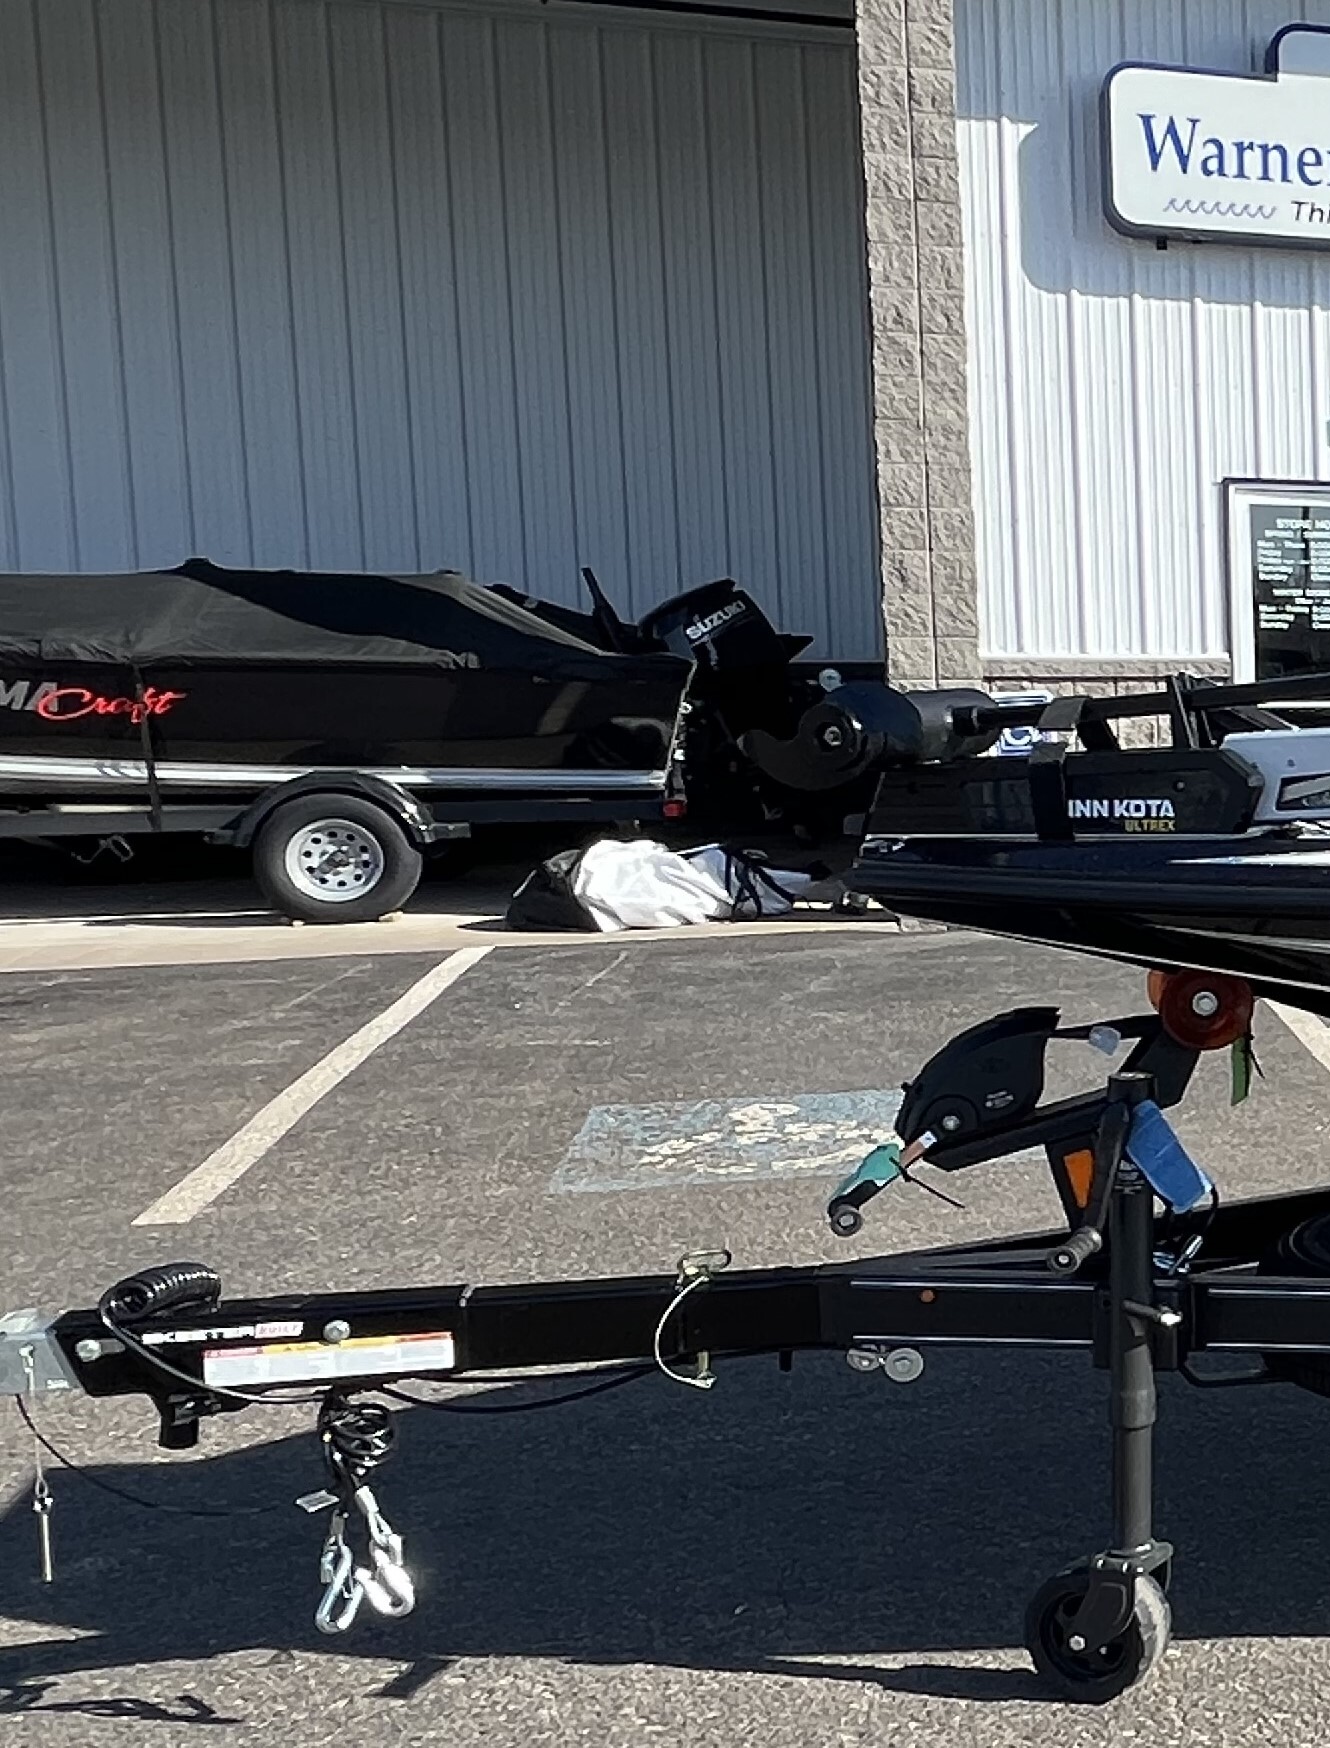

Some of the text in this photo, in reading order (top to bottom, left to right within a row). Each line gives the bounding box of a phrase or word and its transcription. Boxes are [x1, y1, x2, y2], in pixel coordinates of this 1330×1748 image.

[686, 600, 746, 639] SUZUKI
[1068, 799, 1175, 818] INN KOTA
